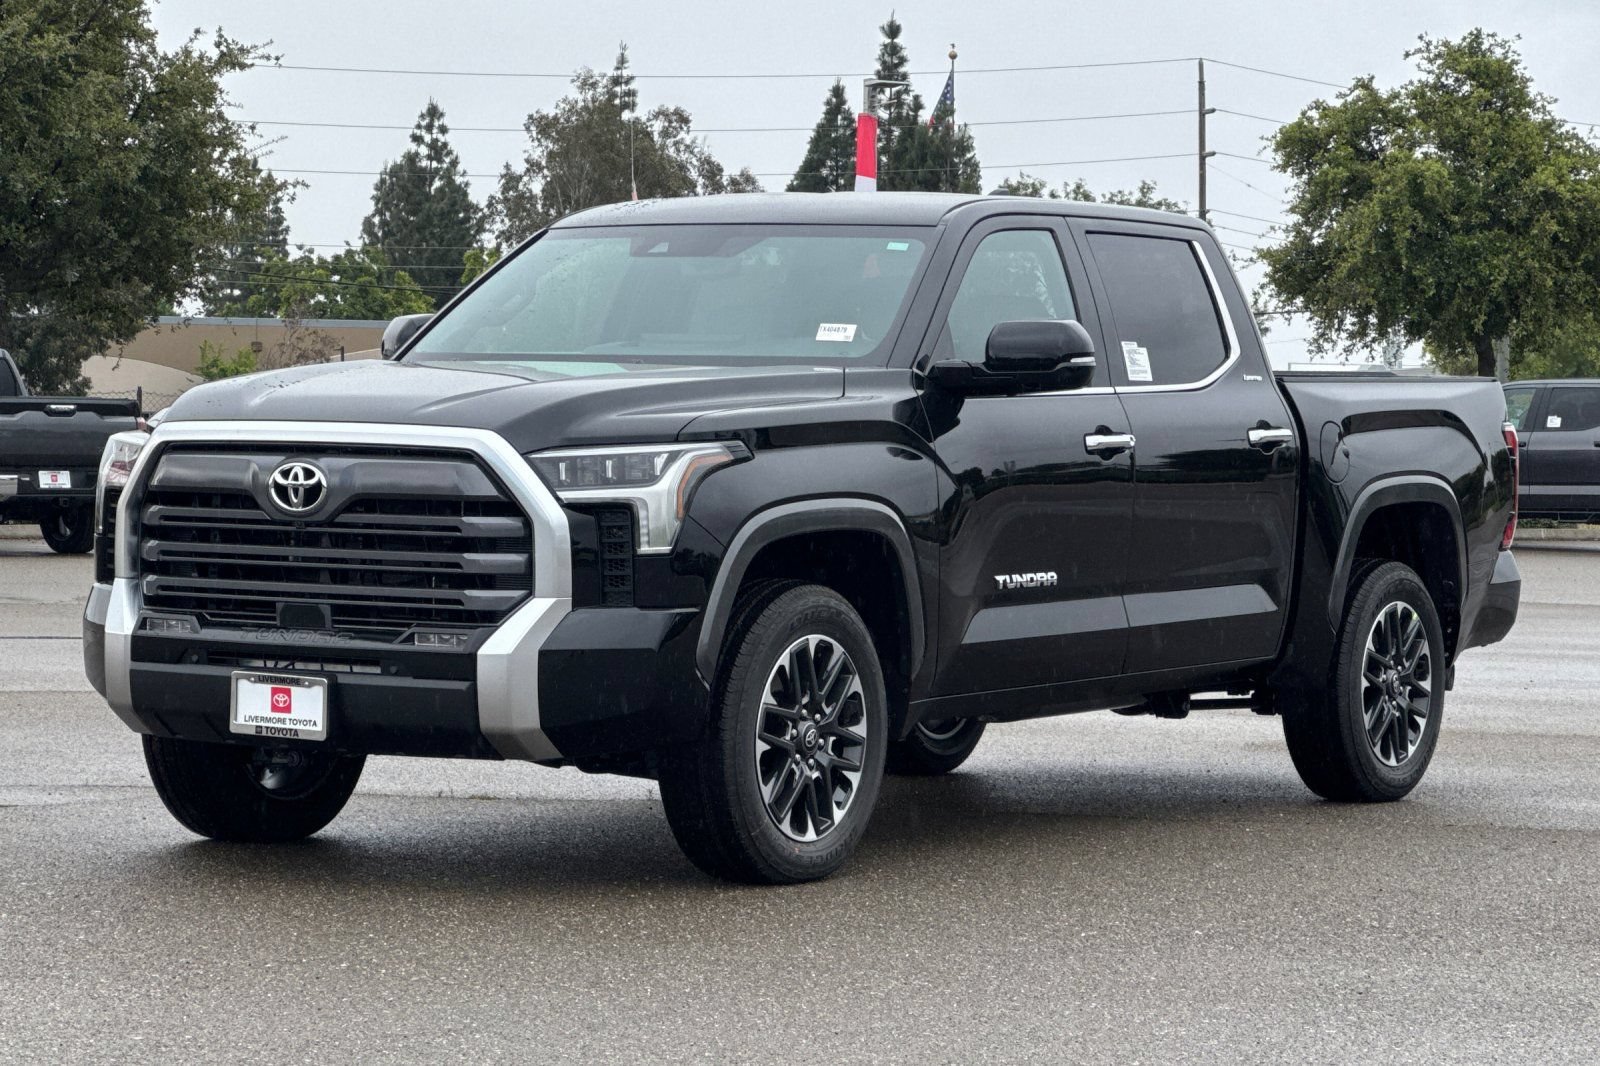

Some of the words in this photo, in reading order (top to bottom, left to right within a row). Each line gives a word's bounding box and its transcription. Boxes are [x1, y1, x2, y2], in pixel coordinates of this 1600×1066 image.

[994, 571, 1058, 590] TUNDRA
[240, 626, 355, 645] TUNDRA
[258, 675, 301, 686] LIVERMORE
[244, 714, 286, 726] LIVERMORE
[288, 718, 318, 728] TOYOTA
[265, 726, 299, 738] TOYOTA
